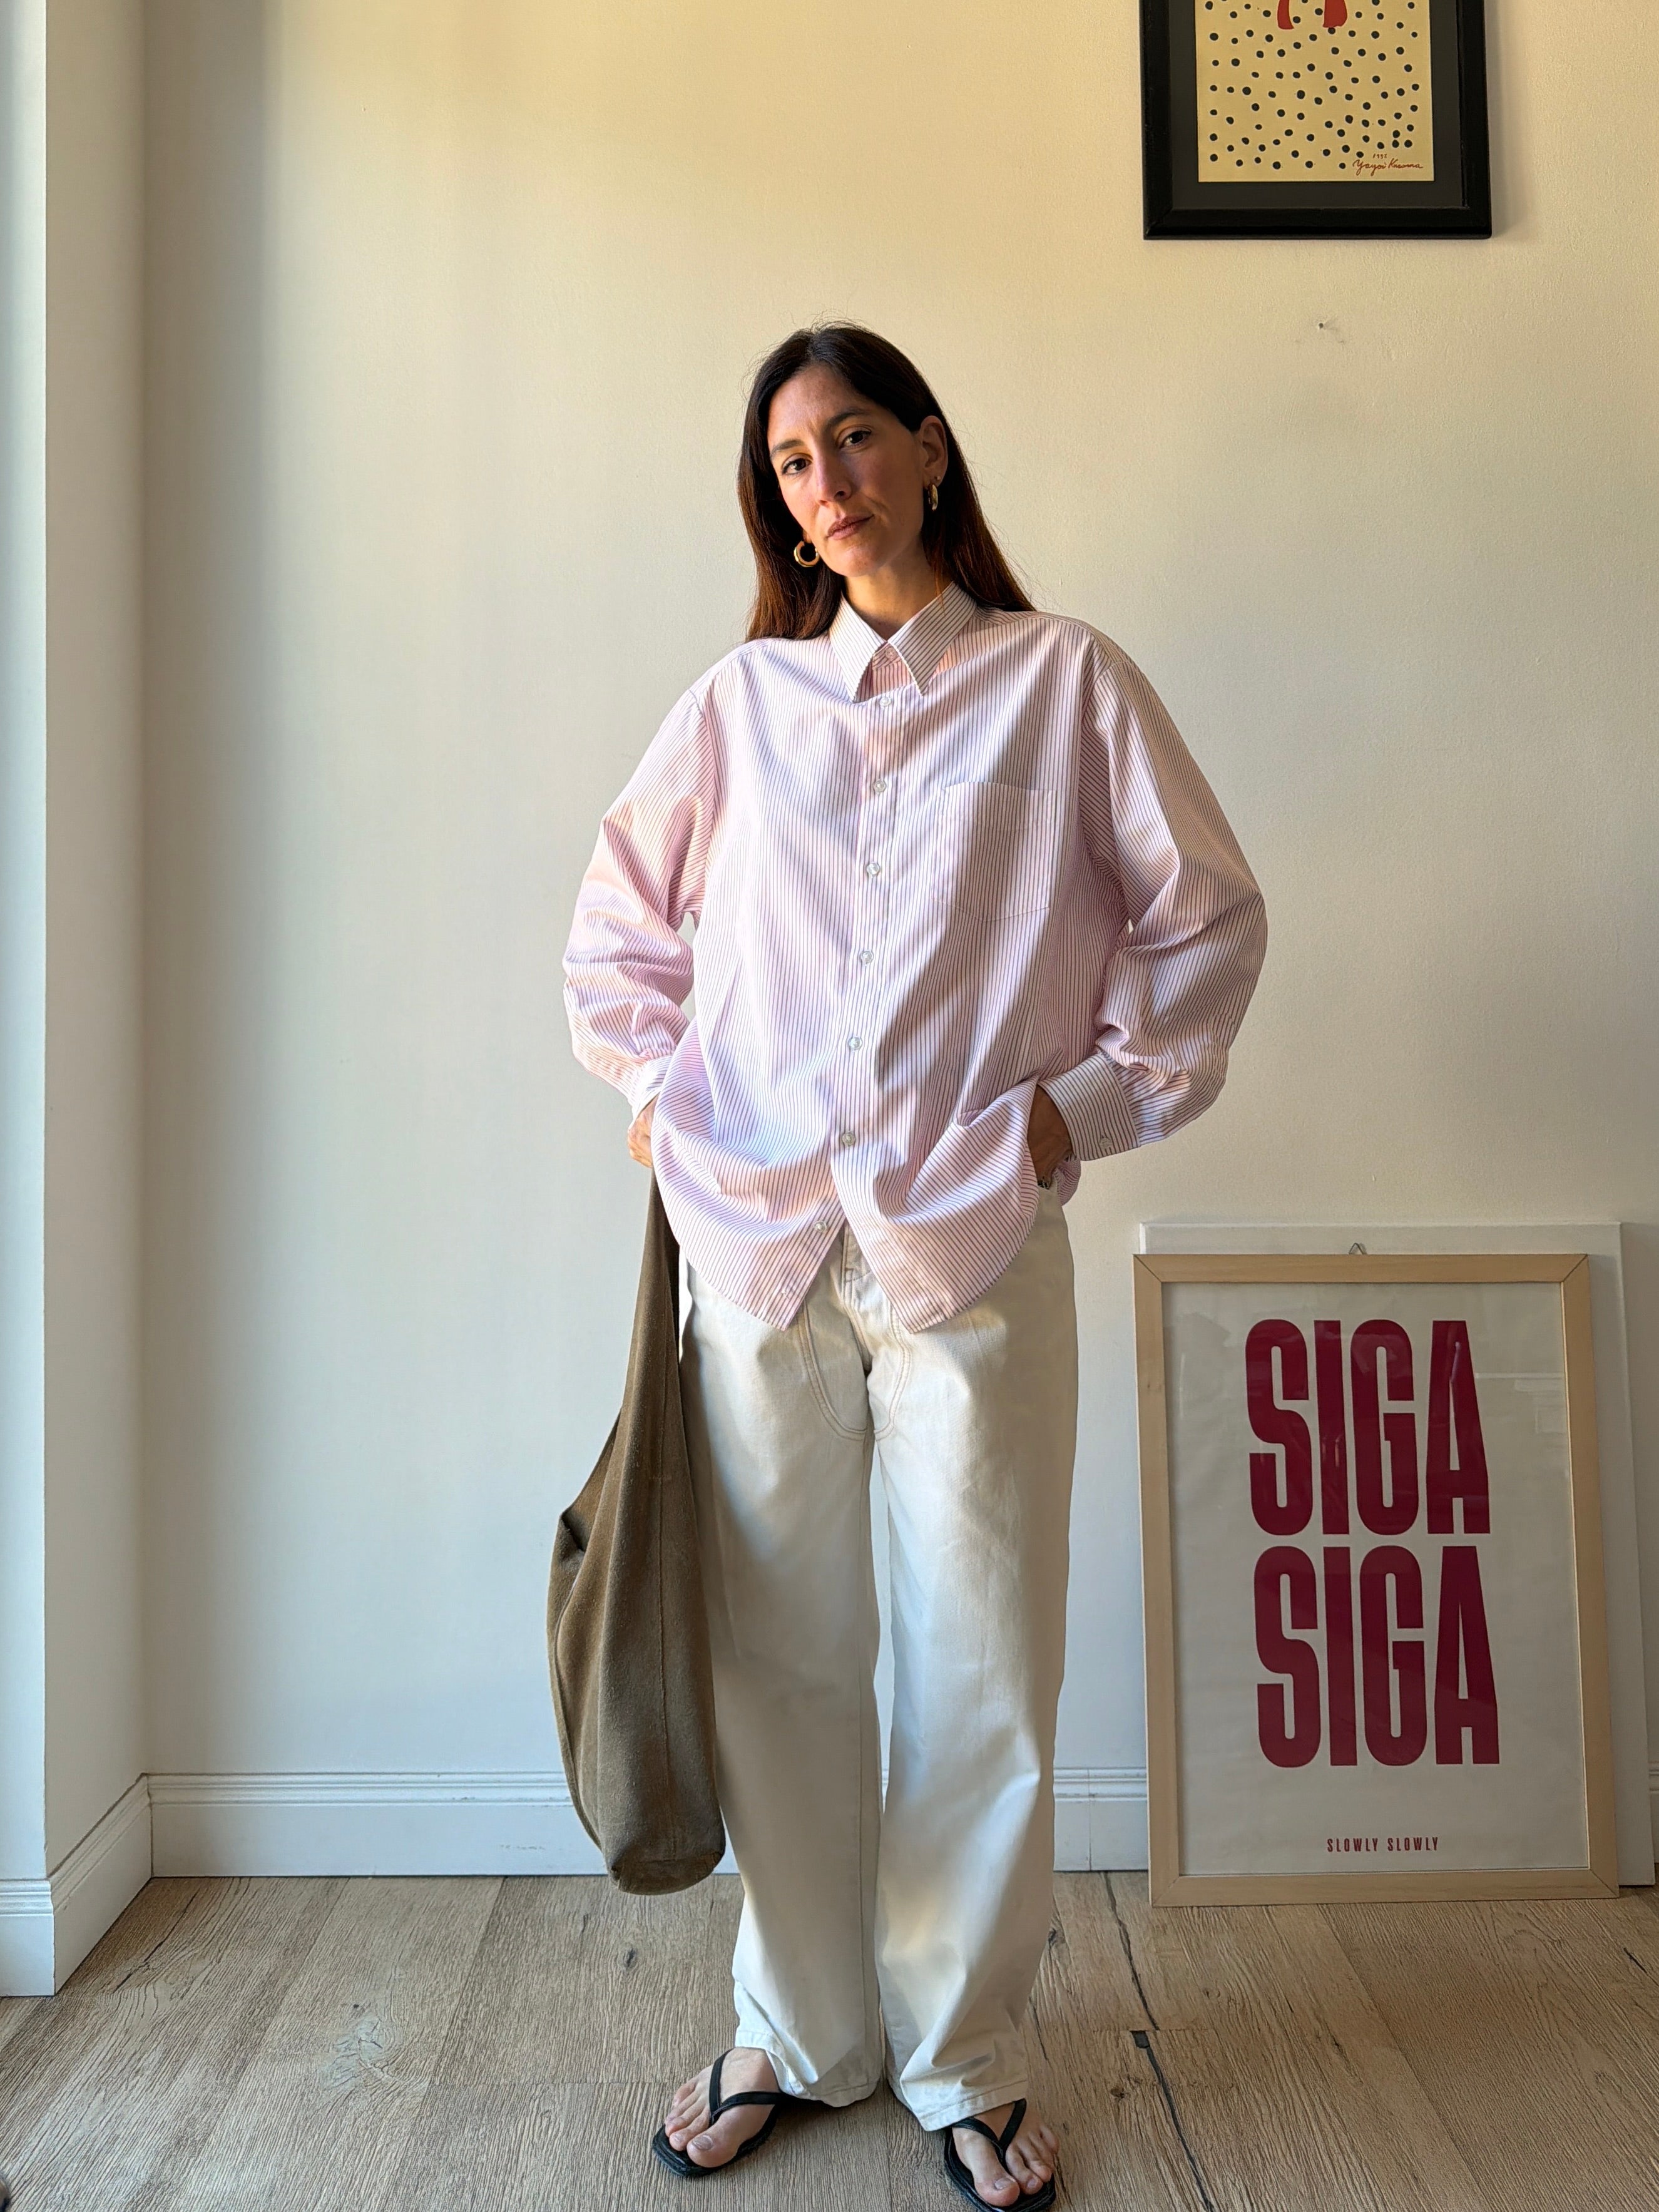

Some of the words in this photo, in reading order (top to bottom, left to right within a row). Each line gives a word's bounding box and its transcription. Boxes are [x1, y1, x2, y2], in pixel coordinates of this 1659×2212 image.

[1245, 1319, 1490, 1535] SIGA
[1253, 1546, 1499, 1767] SIGA
[1327, 1838, 1378, 1851] SLOWLY
[1387, 1837, 1438, 1851] SLOWLY
